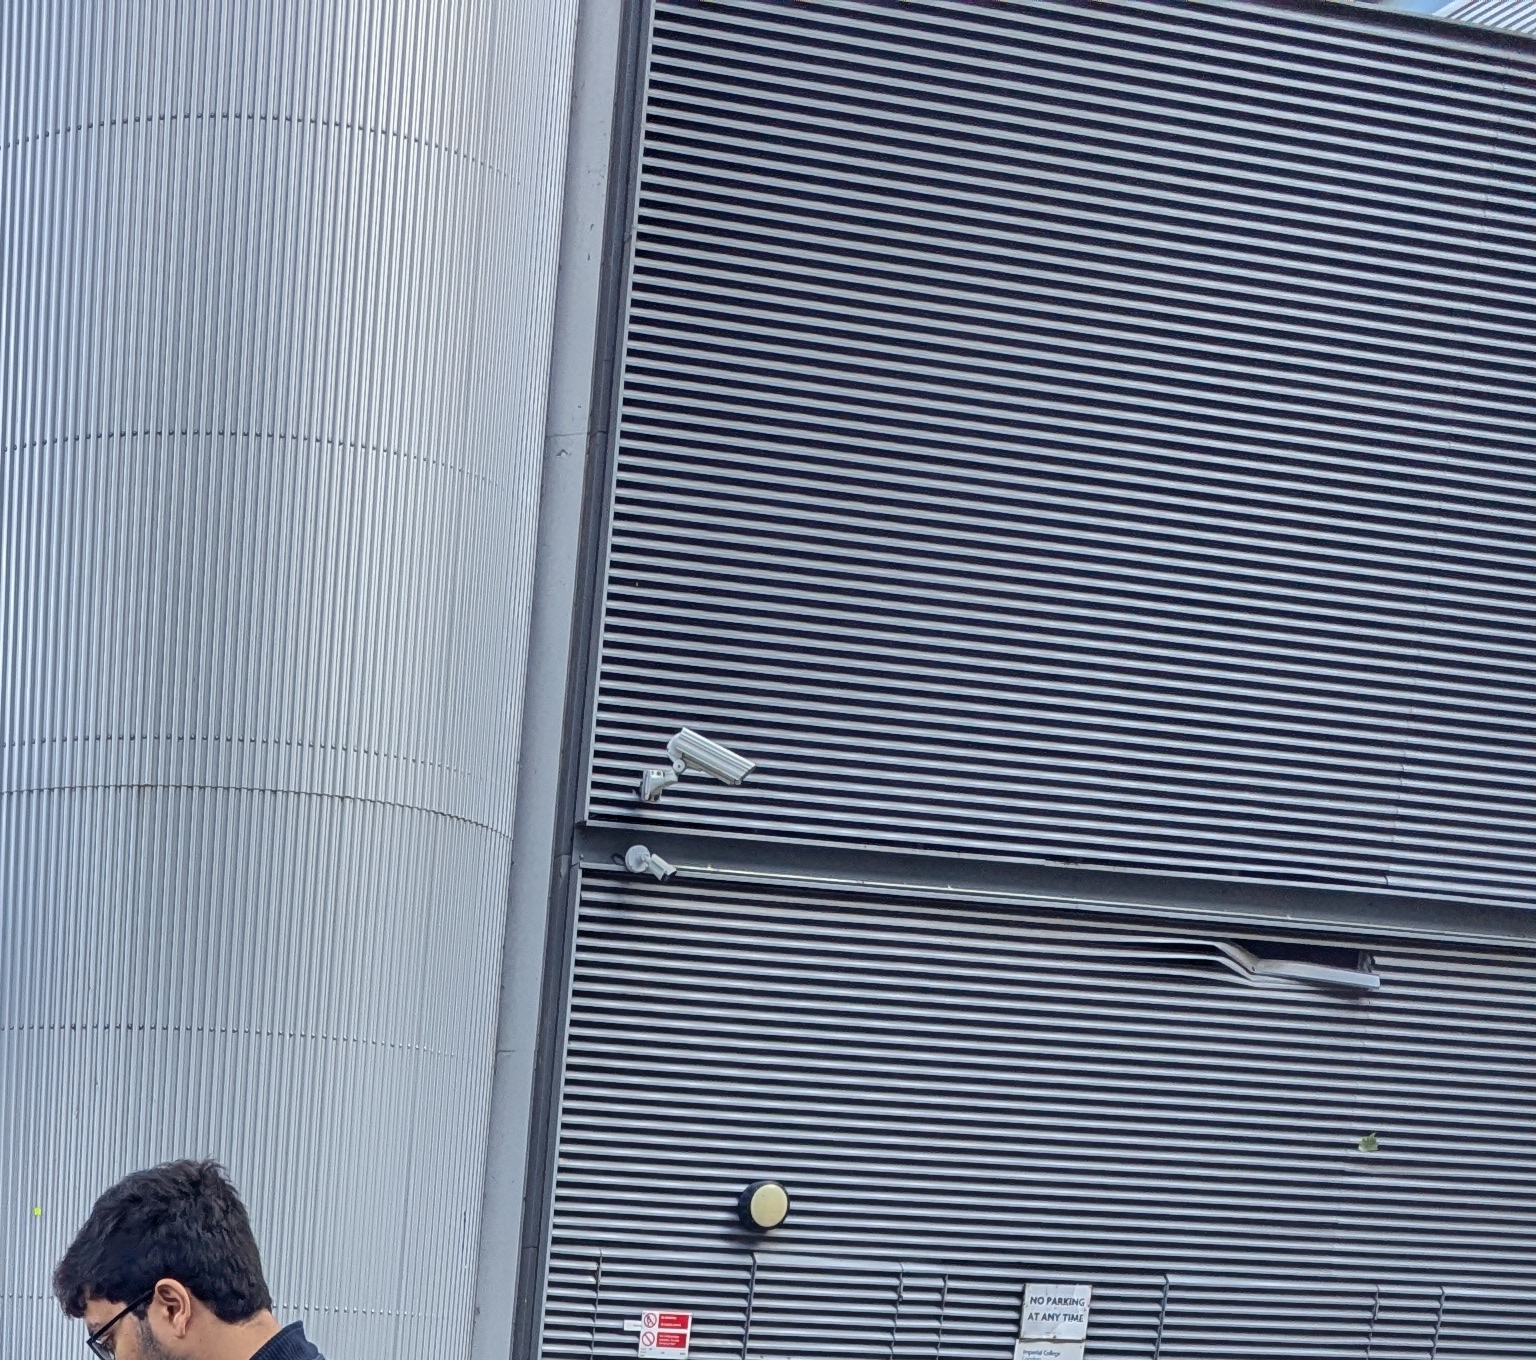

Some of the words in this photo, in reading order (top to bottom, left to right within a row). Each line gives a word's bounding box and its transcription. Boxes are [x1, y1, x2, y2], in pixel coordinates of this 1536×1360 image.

[1030, 1296, 1044, 1305] NO
[1046, 1296, 1085, 1307] PARKING
[1027, 1312, 1040, 1321] AT
[1041, 1312, 1061, 1322] ANY
[1063, 1313, 1084, 1322] TIME
